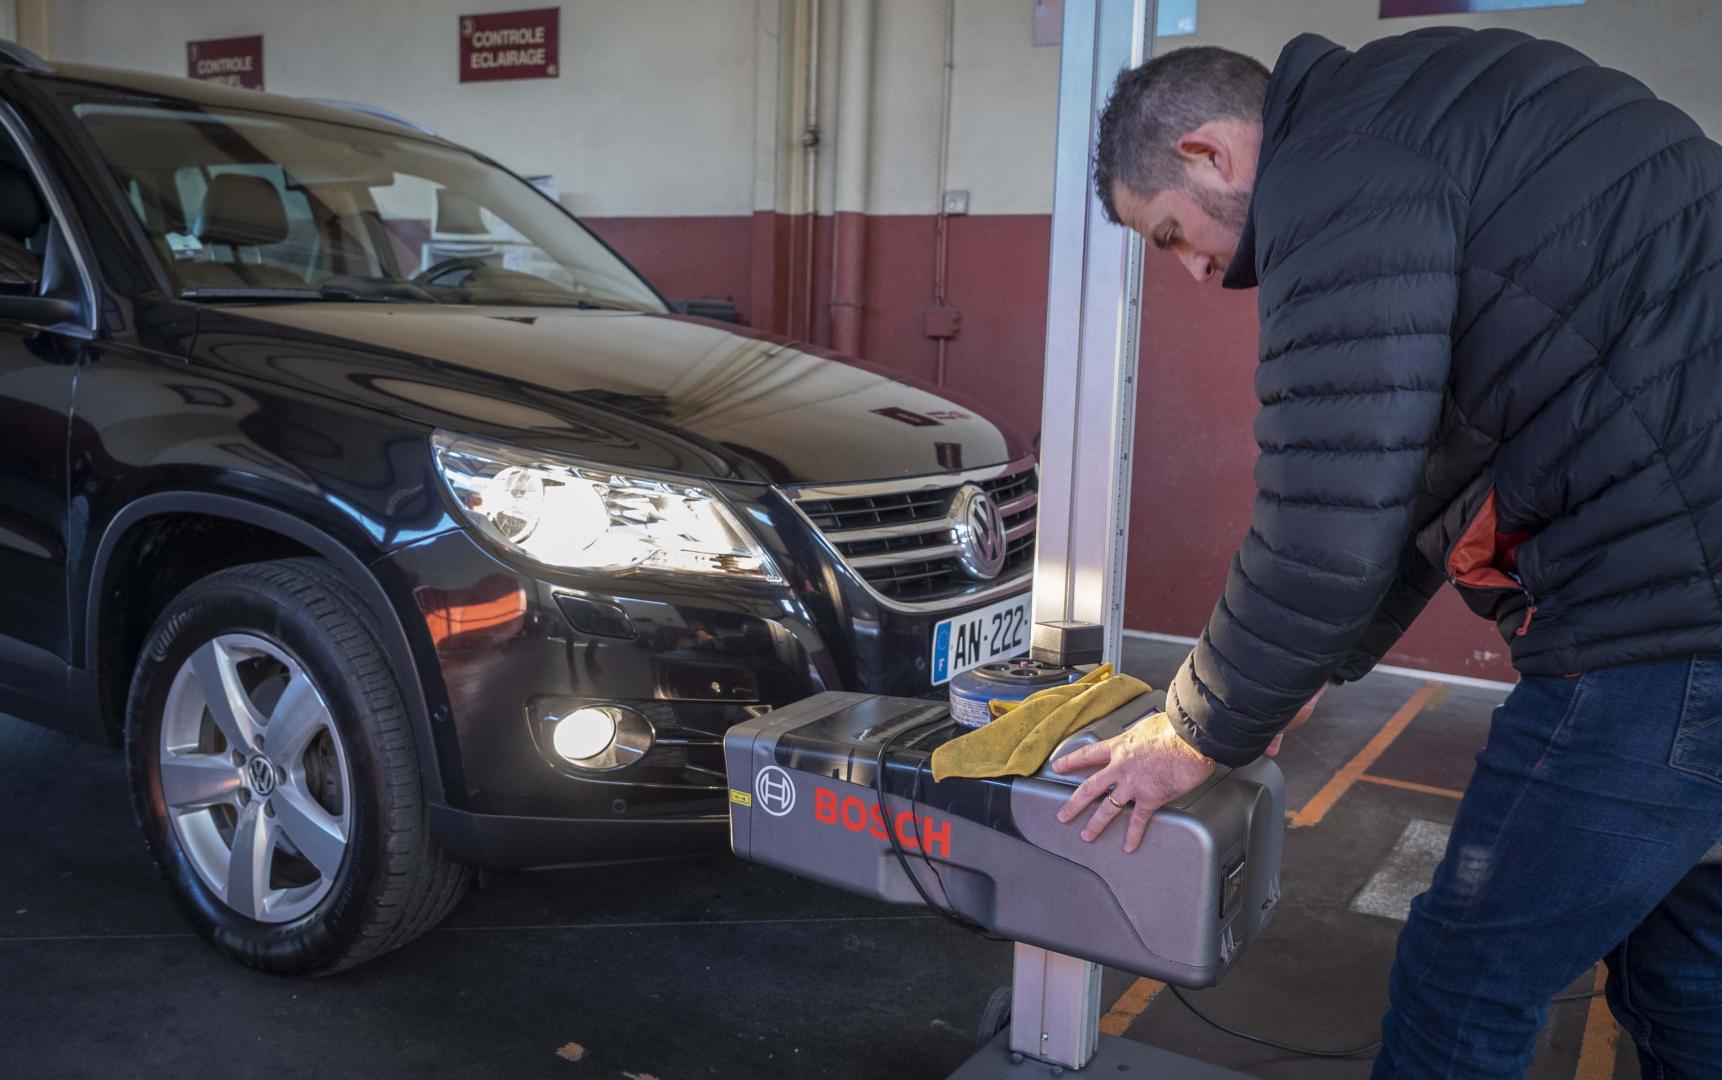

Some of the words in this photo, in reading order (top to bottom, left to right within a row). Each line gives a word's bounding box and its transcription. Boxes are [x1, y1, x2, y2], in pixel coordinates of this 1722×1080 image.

[472, 27, 545, 48] CONTROLE
[197, 56, 254, 74] CONTROLE
[470, 48, 546, 69] ECLAIRAGE
[938, 657, 945, 672] F
[814, 786, 952, 858] BOSCH
